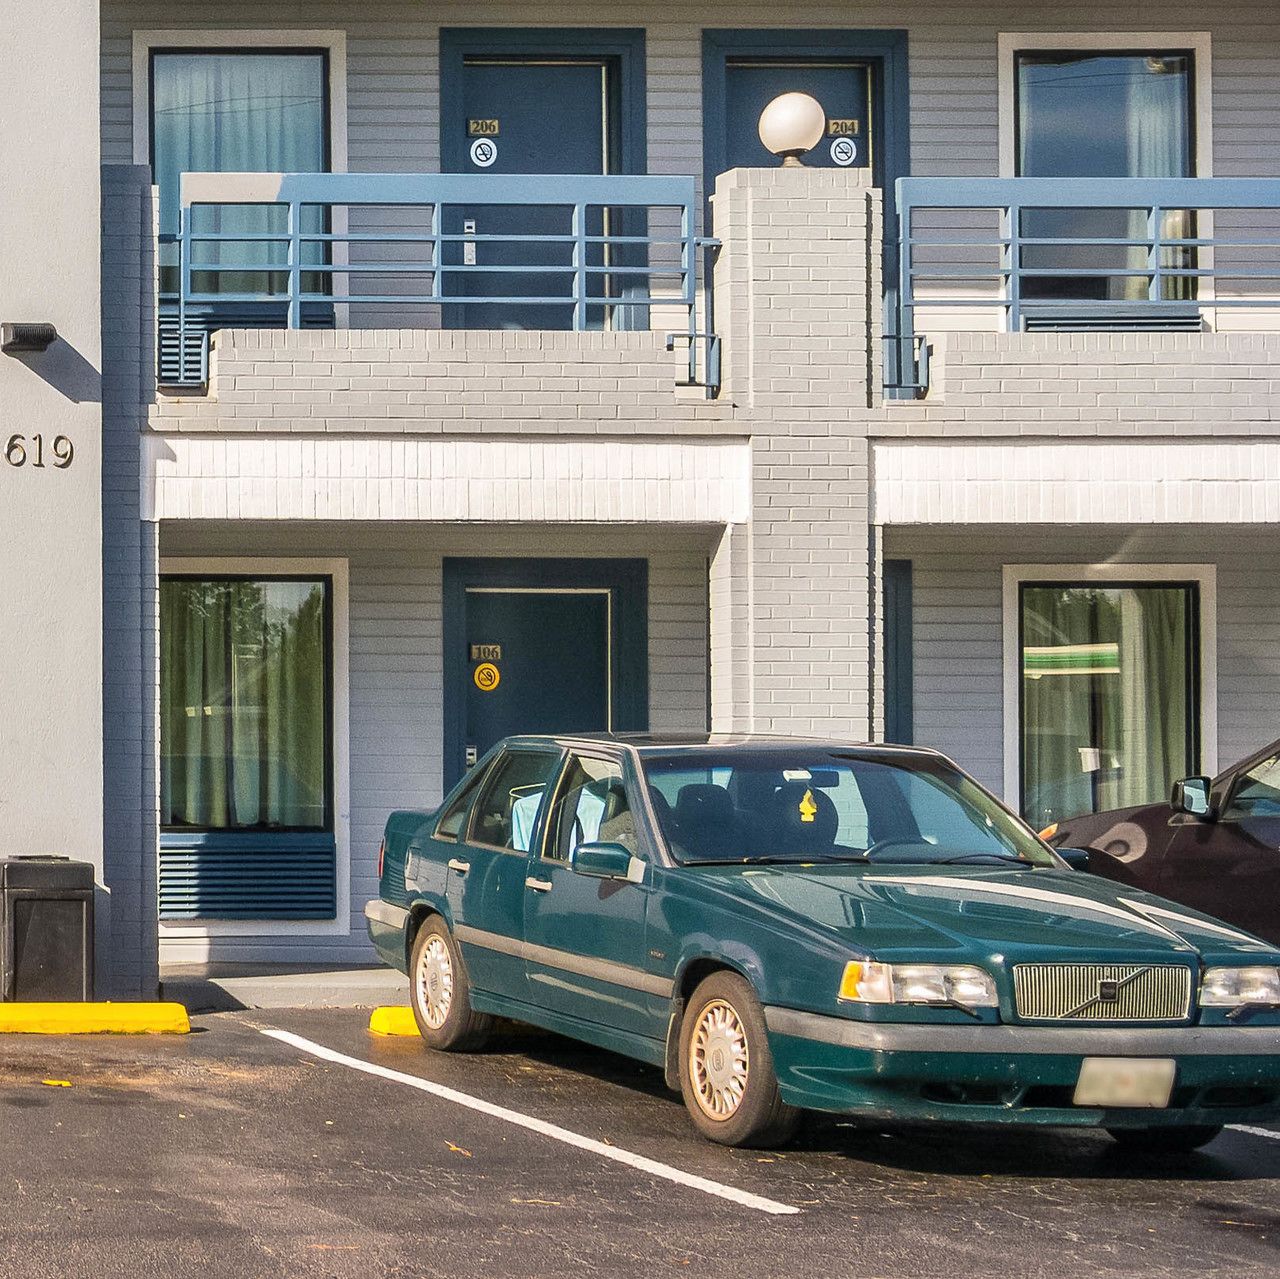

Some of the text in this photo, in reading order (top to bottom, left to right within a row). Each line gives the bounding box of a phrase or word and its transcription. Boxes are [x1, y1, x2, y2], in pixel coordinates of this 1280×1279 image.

[471, 121, 496, 133] 206
[832, 121, 856, 134] 204
[476, 646, 499, 659] 106
